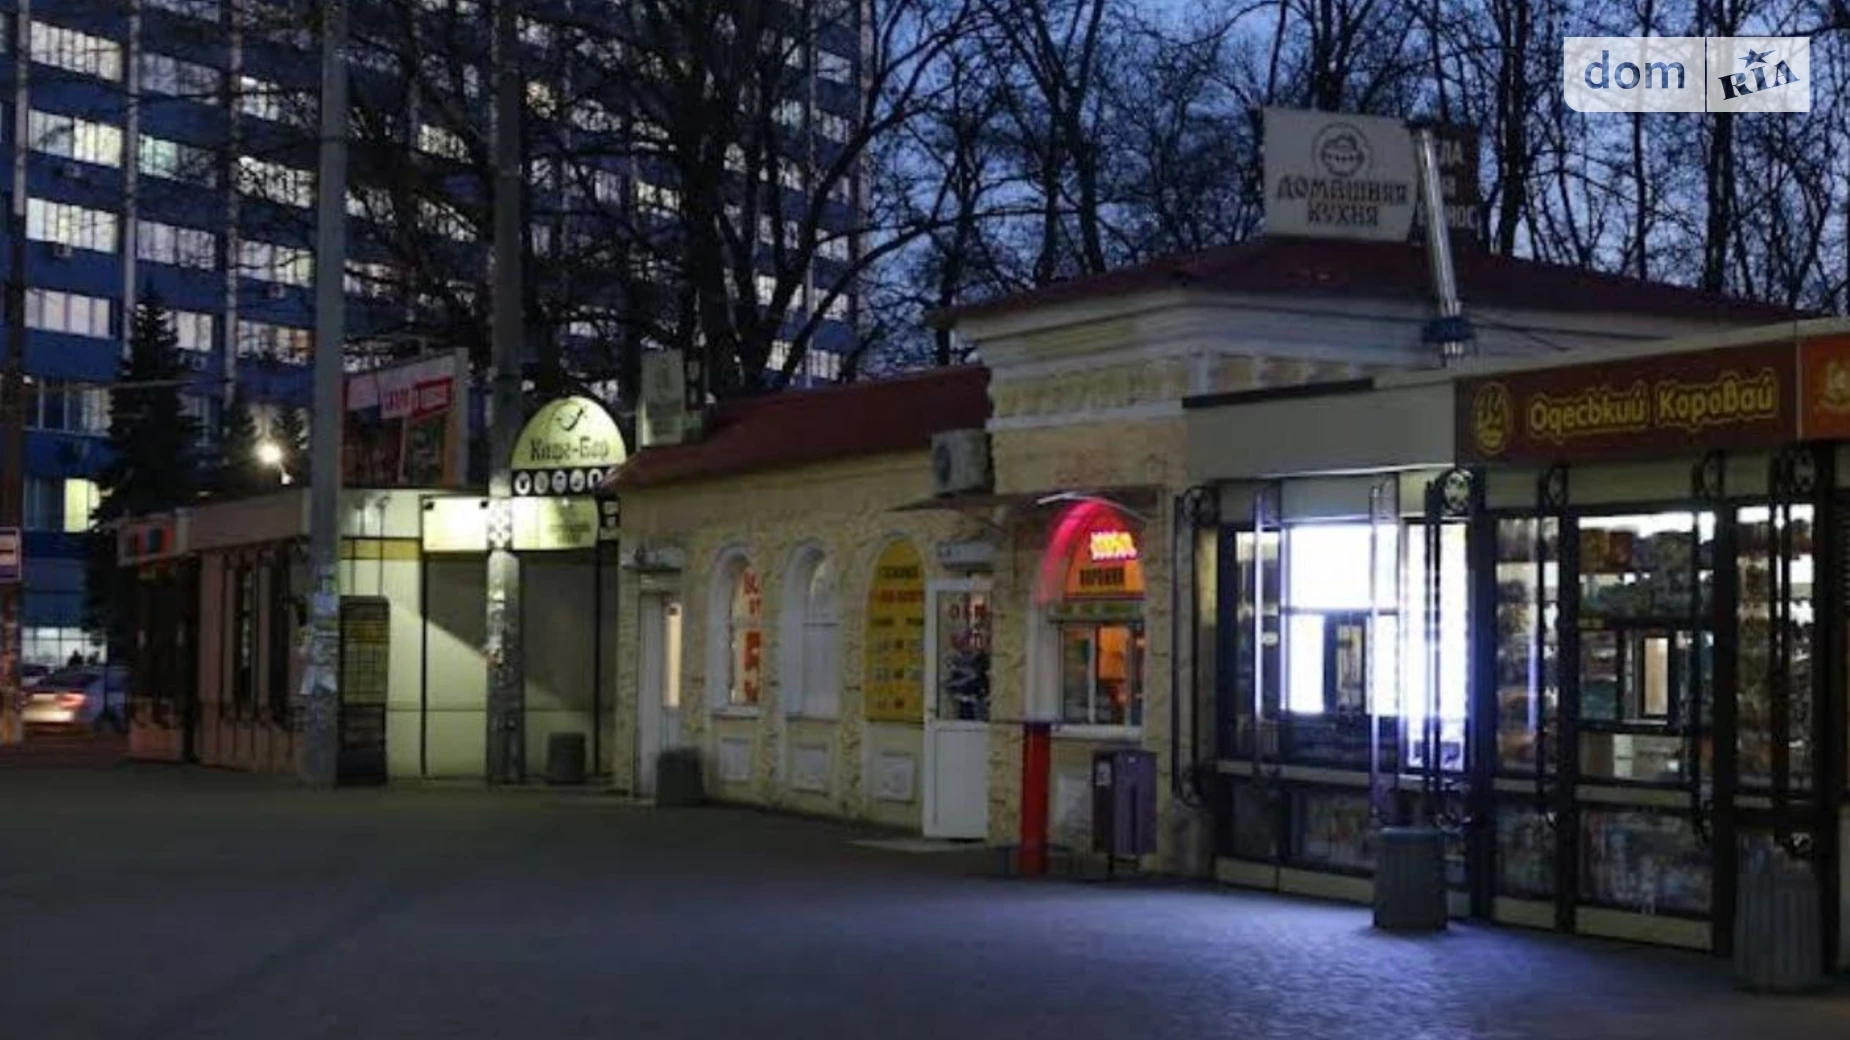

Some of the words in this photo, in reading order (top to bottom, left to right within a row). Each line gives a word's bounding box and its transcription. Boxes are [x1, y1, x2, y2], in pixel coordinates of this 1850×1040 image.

[1277, 175, 1408, 206] ДОМАШНЯЯ
[1307, 203, 1379, 227] КУХНЯ
[1528, 383, 1647, 435] Одеський
[1657, 374, 1777, 426] Коровай
